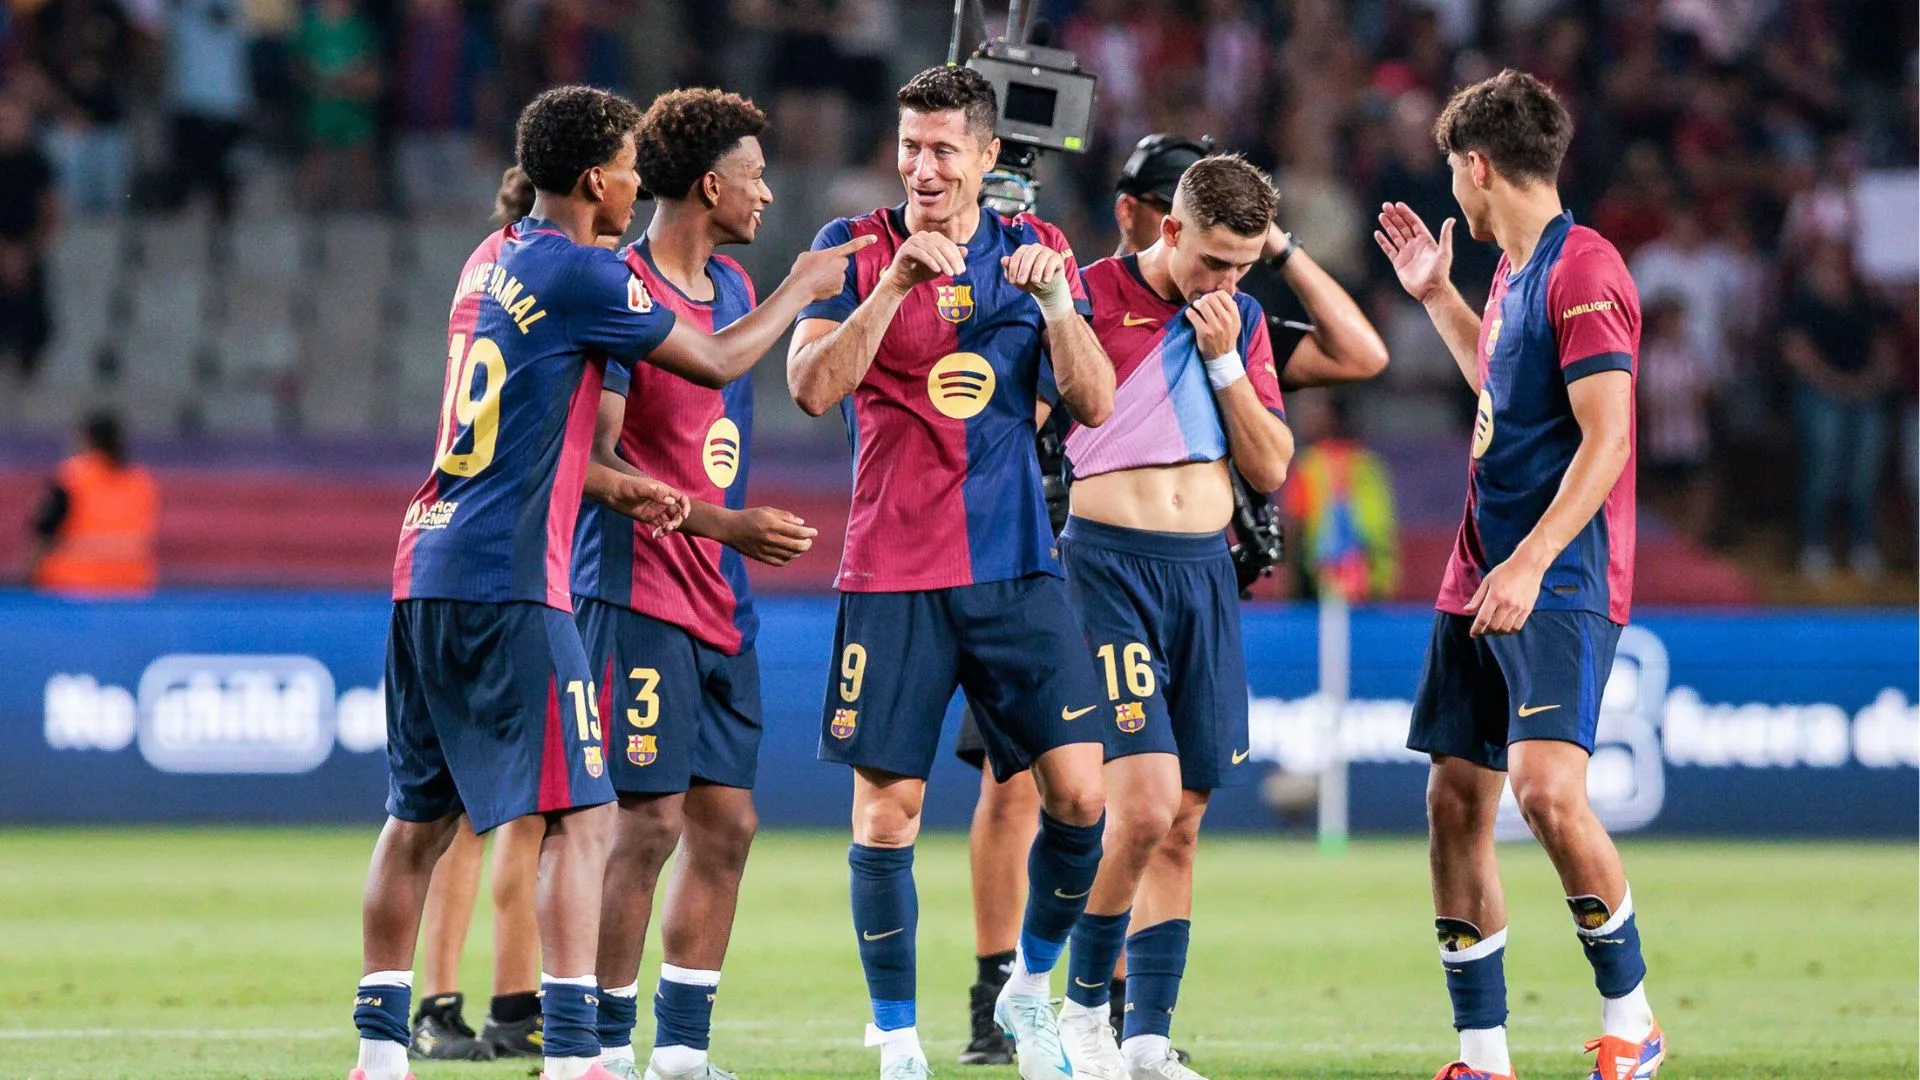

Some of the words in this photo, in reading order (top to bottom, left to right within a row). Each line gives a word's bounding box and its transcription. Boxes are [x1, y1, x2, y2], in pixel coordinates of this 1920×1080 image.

[487, 264, 547, 335] YAMAL
[1562, 301, 1612, 320] AMBILIGHT
[436, 333, 507, 478] 19
[627, 667, 661, 728] 3
[840, 643, 867, 702] 9
[1097, 642, 1156, 700] 16
[567, 680, 602, 741] 19
